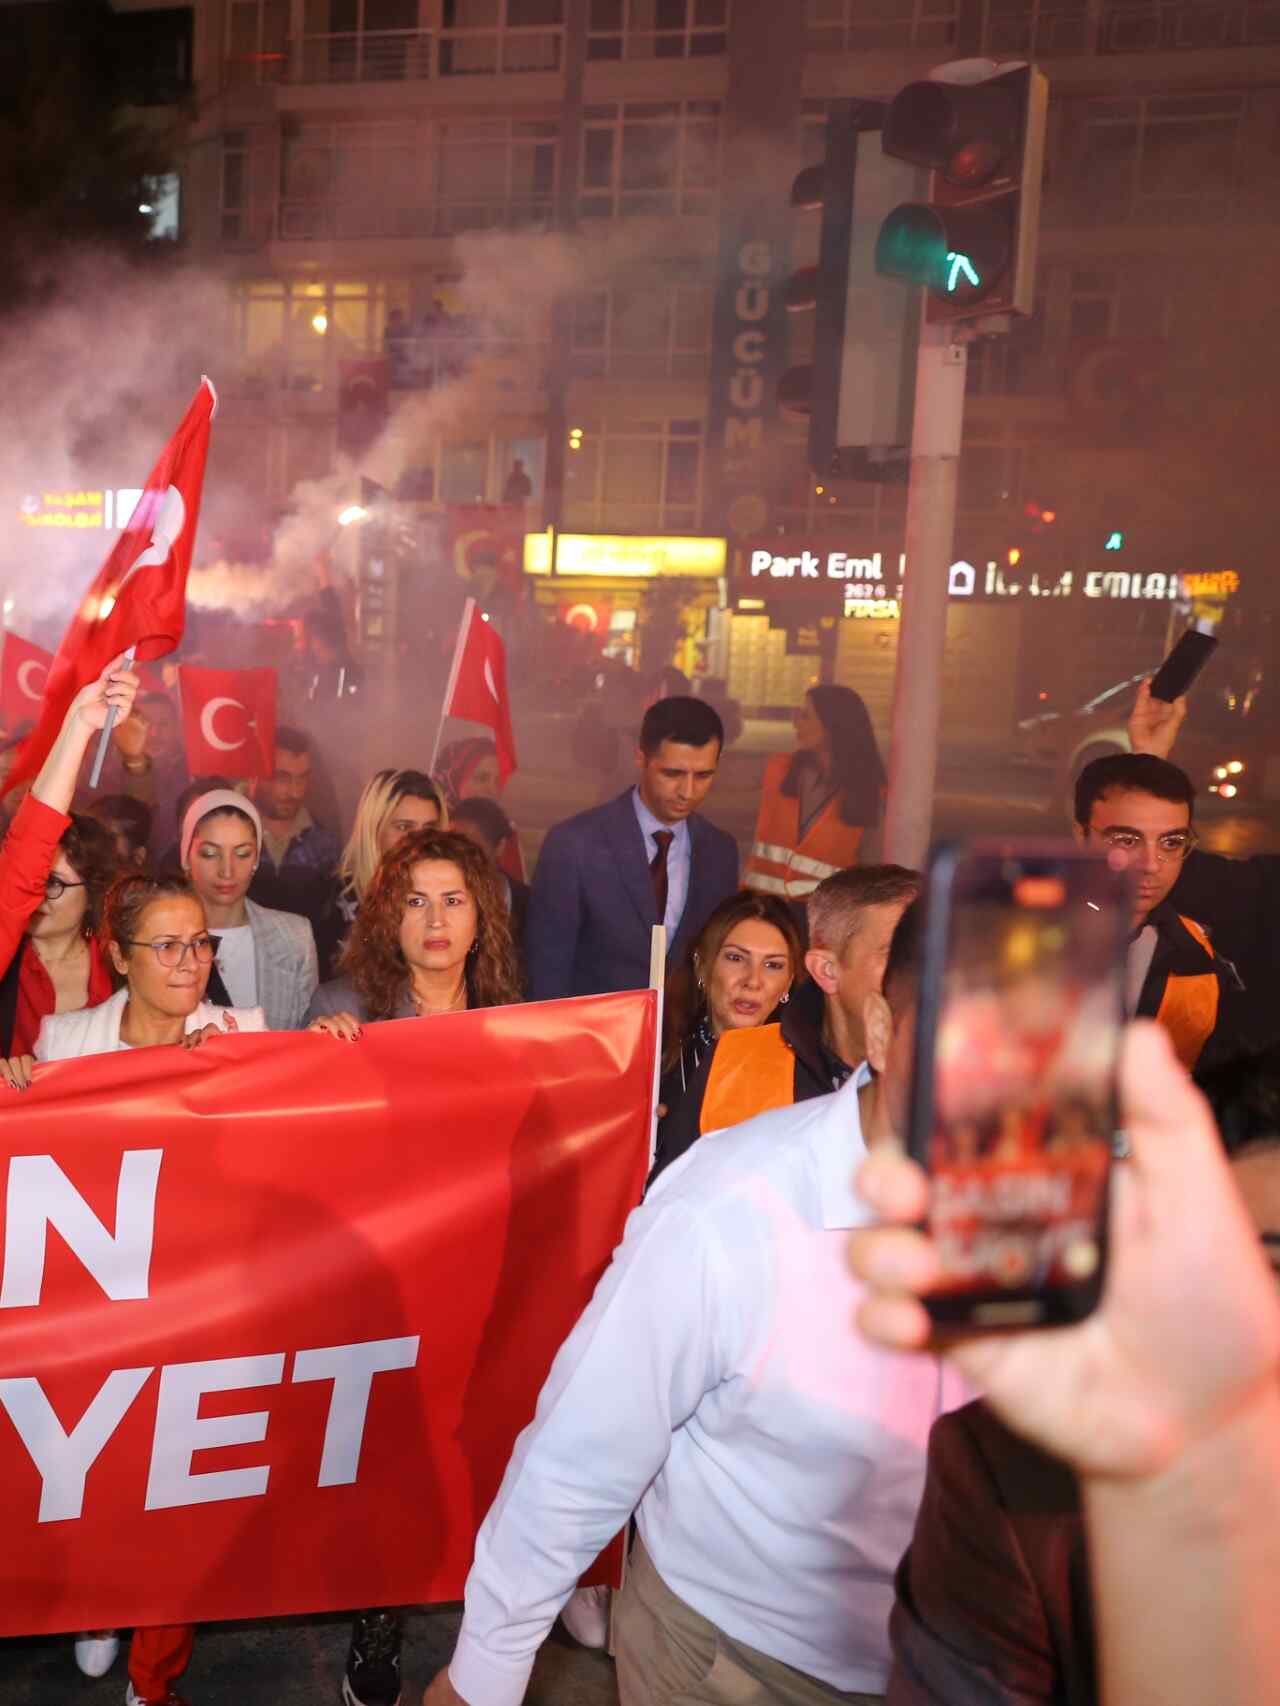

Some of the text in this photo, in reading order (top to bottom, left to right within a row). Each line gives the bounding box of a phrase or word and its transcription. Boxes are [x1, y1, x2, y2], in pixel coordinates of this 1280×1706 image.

[751, 551, 906, 580] Park Eml
[844, 599, 900, 618] FIRSA
